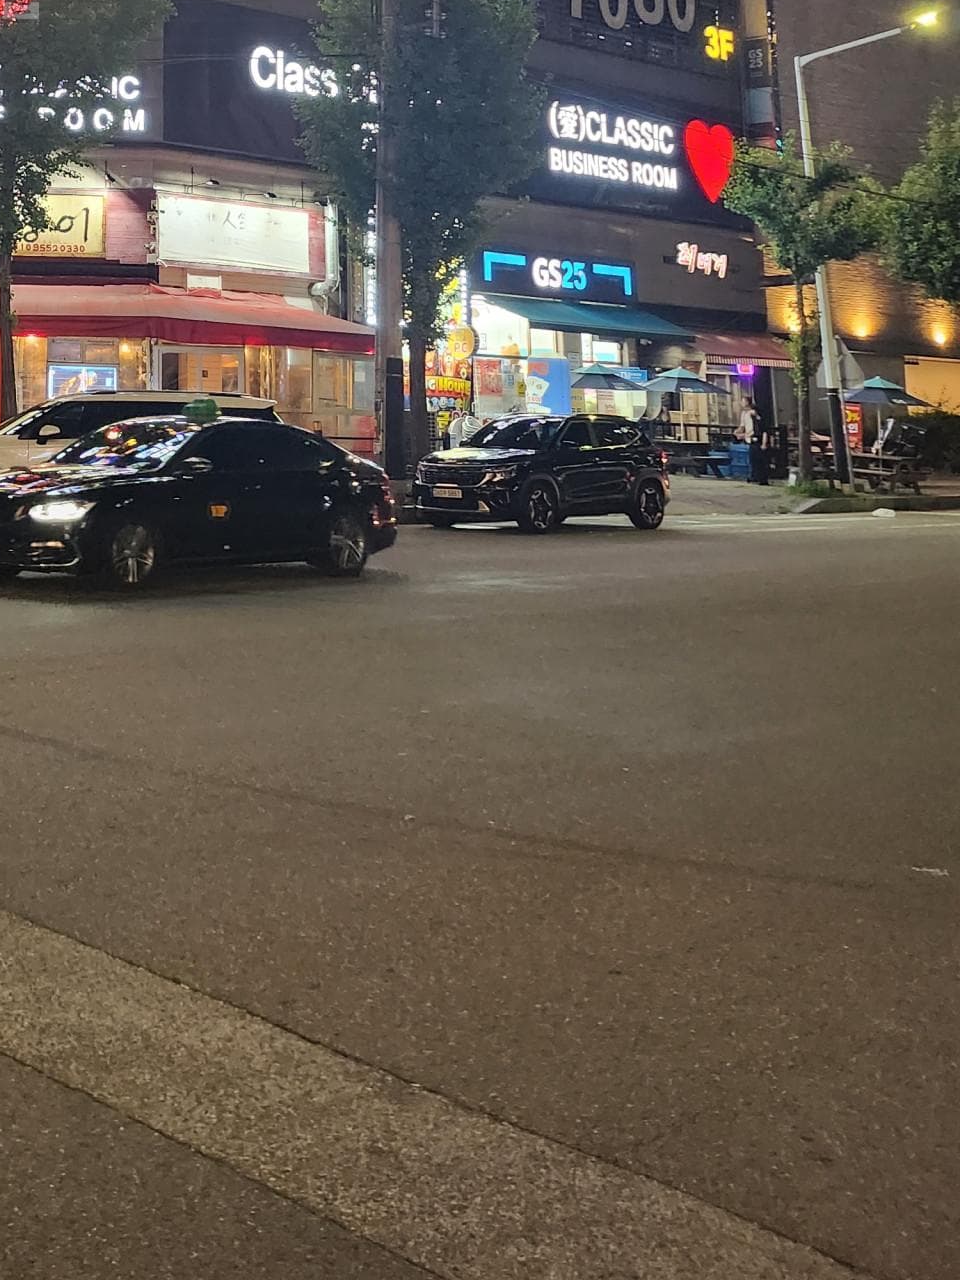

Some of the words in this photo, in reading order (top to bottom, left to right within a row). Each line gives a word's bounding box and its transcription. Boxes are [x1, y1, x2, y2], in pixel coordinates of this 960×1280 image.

[703, 25, 735, 61] 3F
[248, 45, 338, 97] Class
[549, 147, 628, 183] BUSINESS
[631, 161, 678, 190] ROOM
[532, 257, 588, 291] GS25
